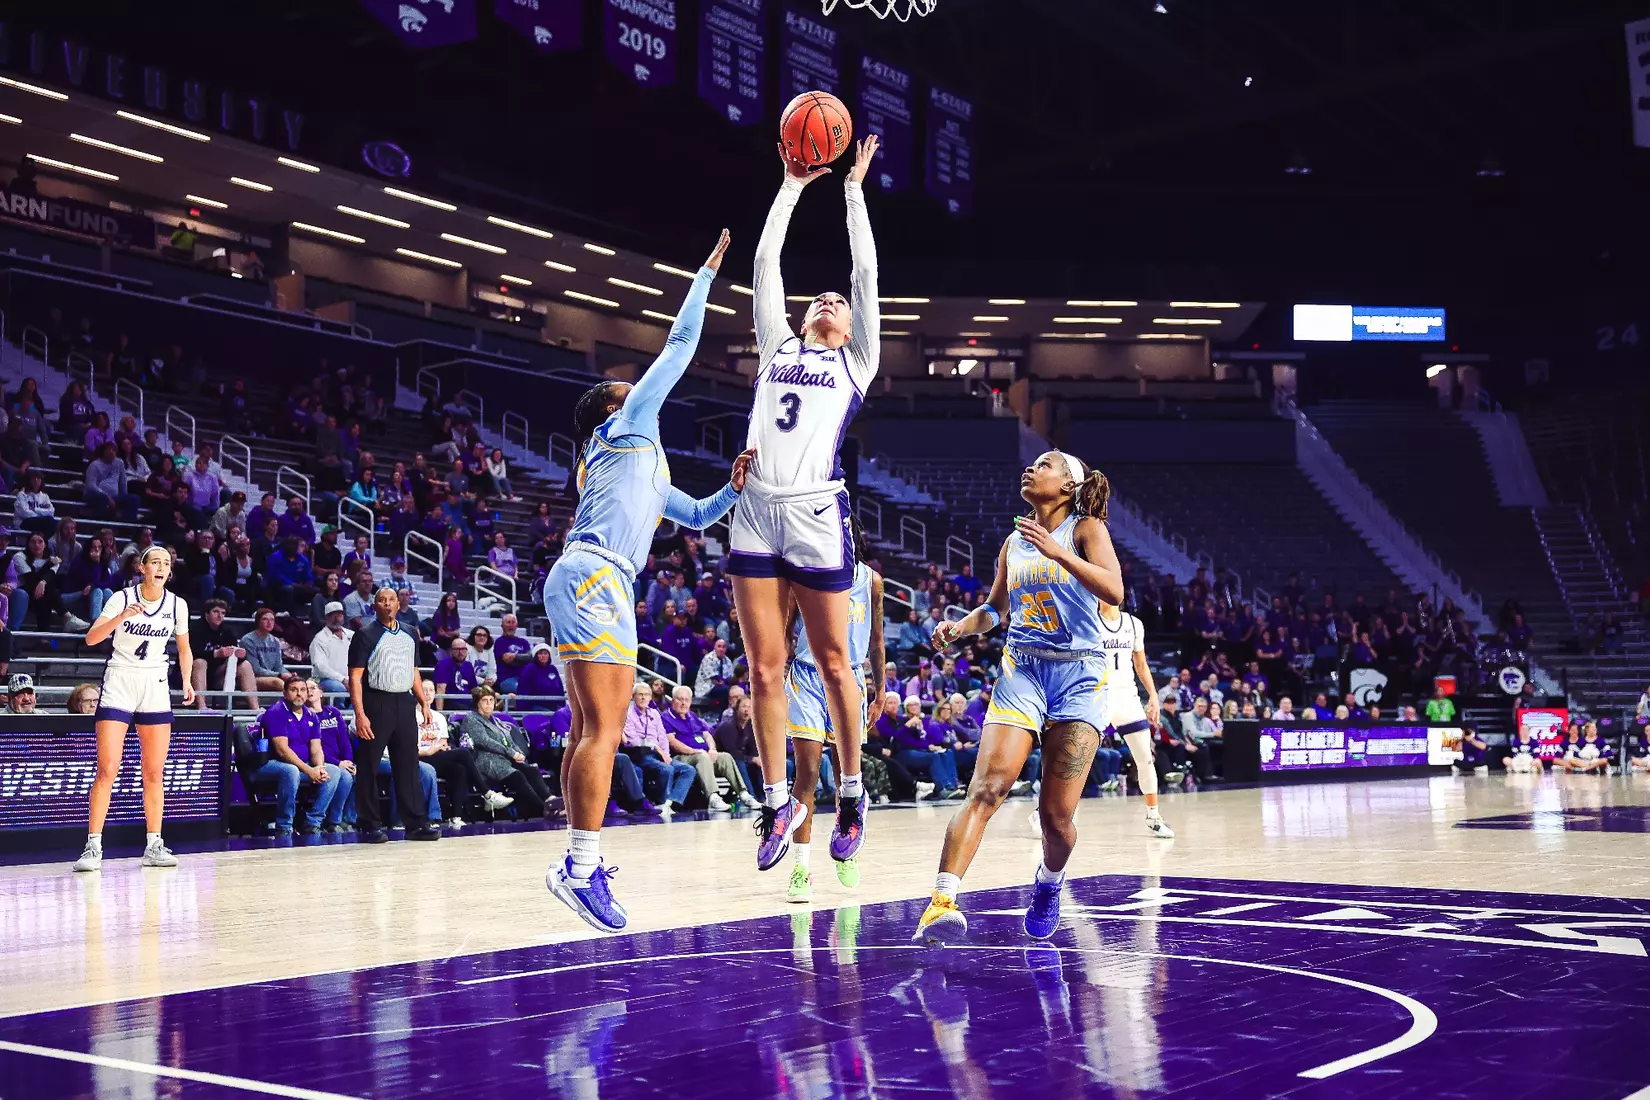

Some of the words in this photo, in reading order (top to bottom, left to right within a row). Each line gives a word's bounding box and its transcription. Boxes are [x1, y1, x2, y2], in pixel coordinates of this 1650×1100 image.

[618, 21, 666, 60] 2019
[785, 11, 837, 45] K-STATE
[862, 56, 909, 88] K-STATE
[931, 87, 973, 117] K-STATE
[765, 363, 836, 389] Wildcats
[775, 392, 802, 433] 3
[1020, 591, 1059, 632] 25
[123, 620, 169, 637] Wildcats
[134, 640, 150, 660] 4
[1113, 652, 1119, 670] 1
